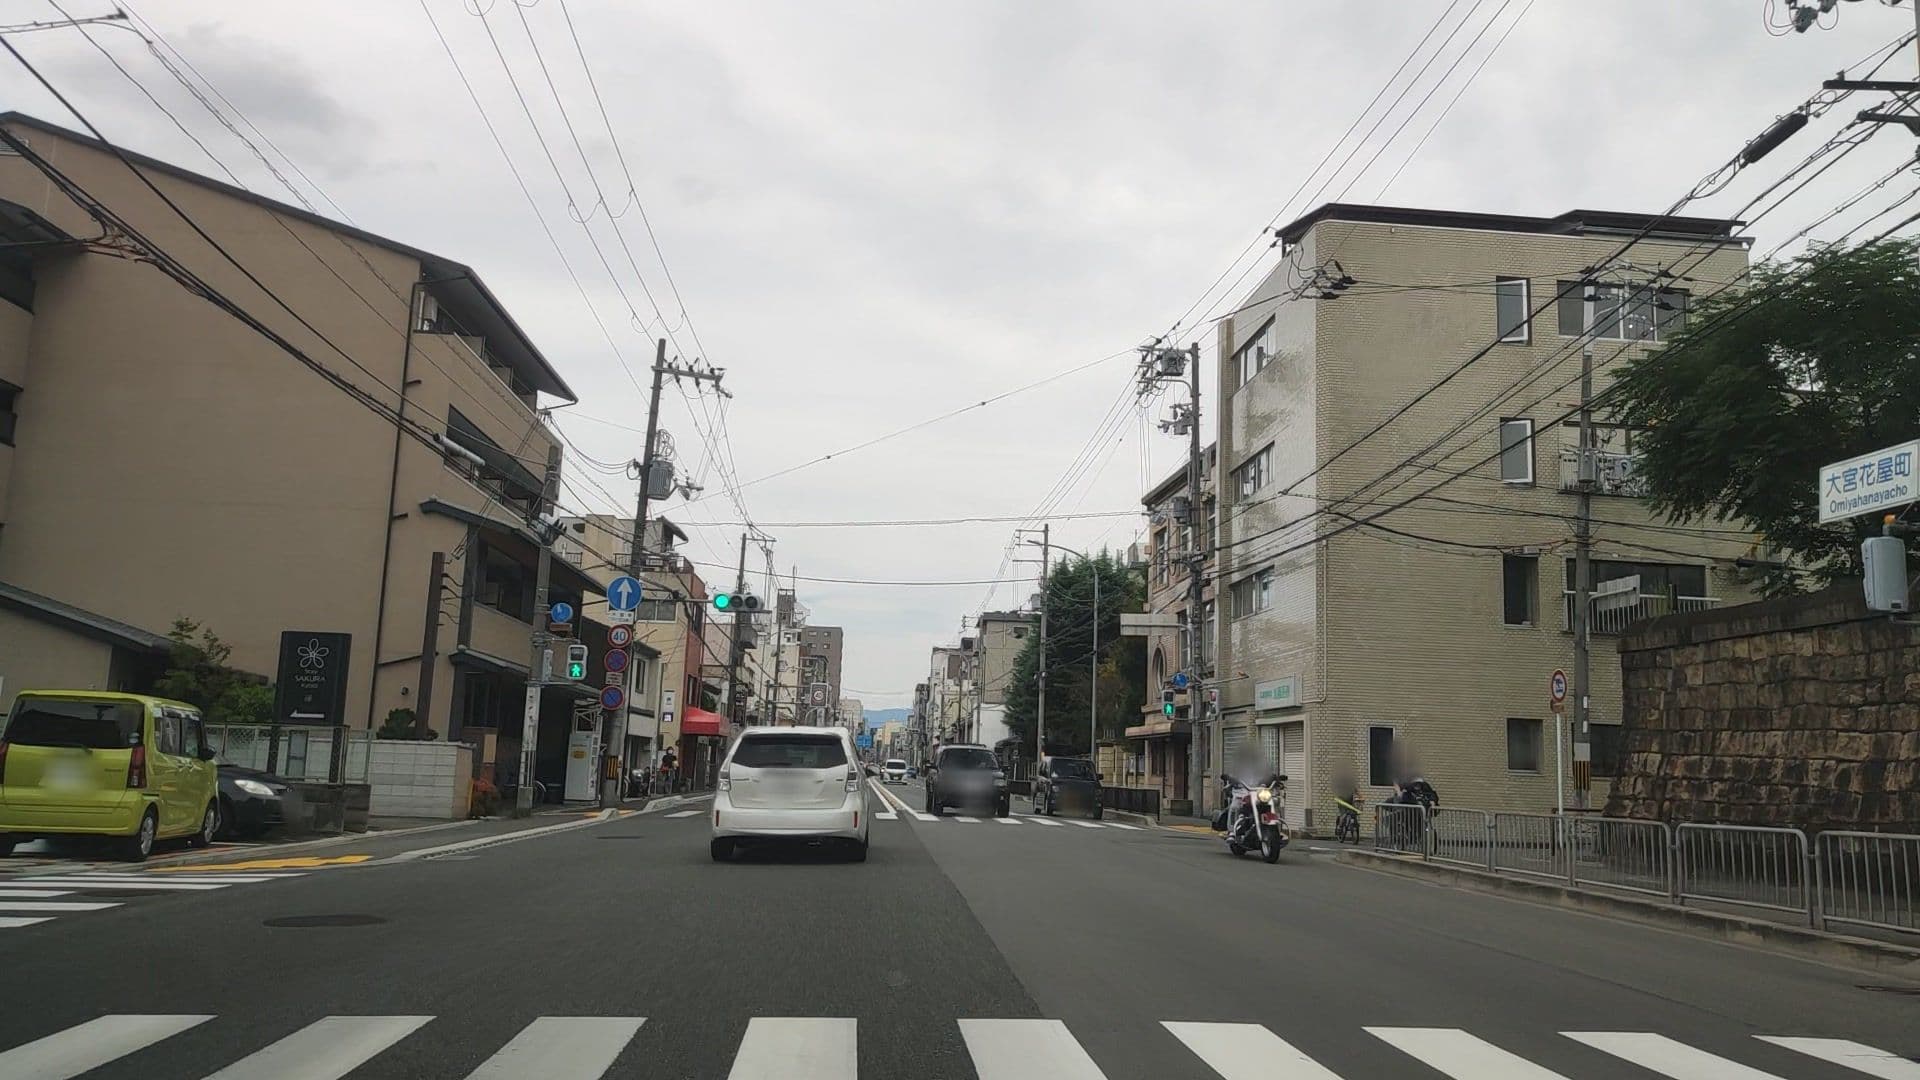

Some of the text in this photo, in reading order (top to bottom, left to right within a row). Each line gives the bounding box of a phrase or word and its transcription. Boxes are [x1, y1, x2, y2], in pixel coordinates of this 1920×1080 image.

[1826, 452, 1912, 497] 大宮花屋町
[1830, 484, 1908, 514] Omiyahanayacho
[613, 631, 625, 641] 40
